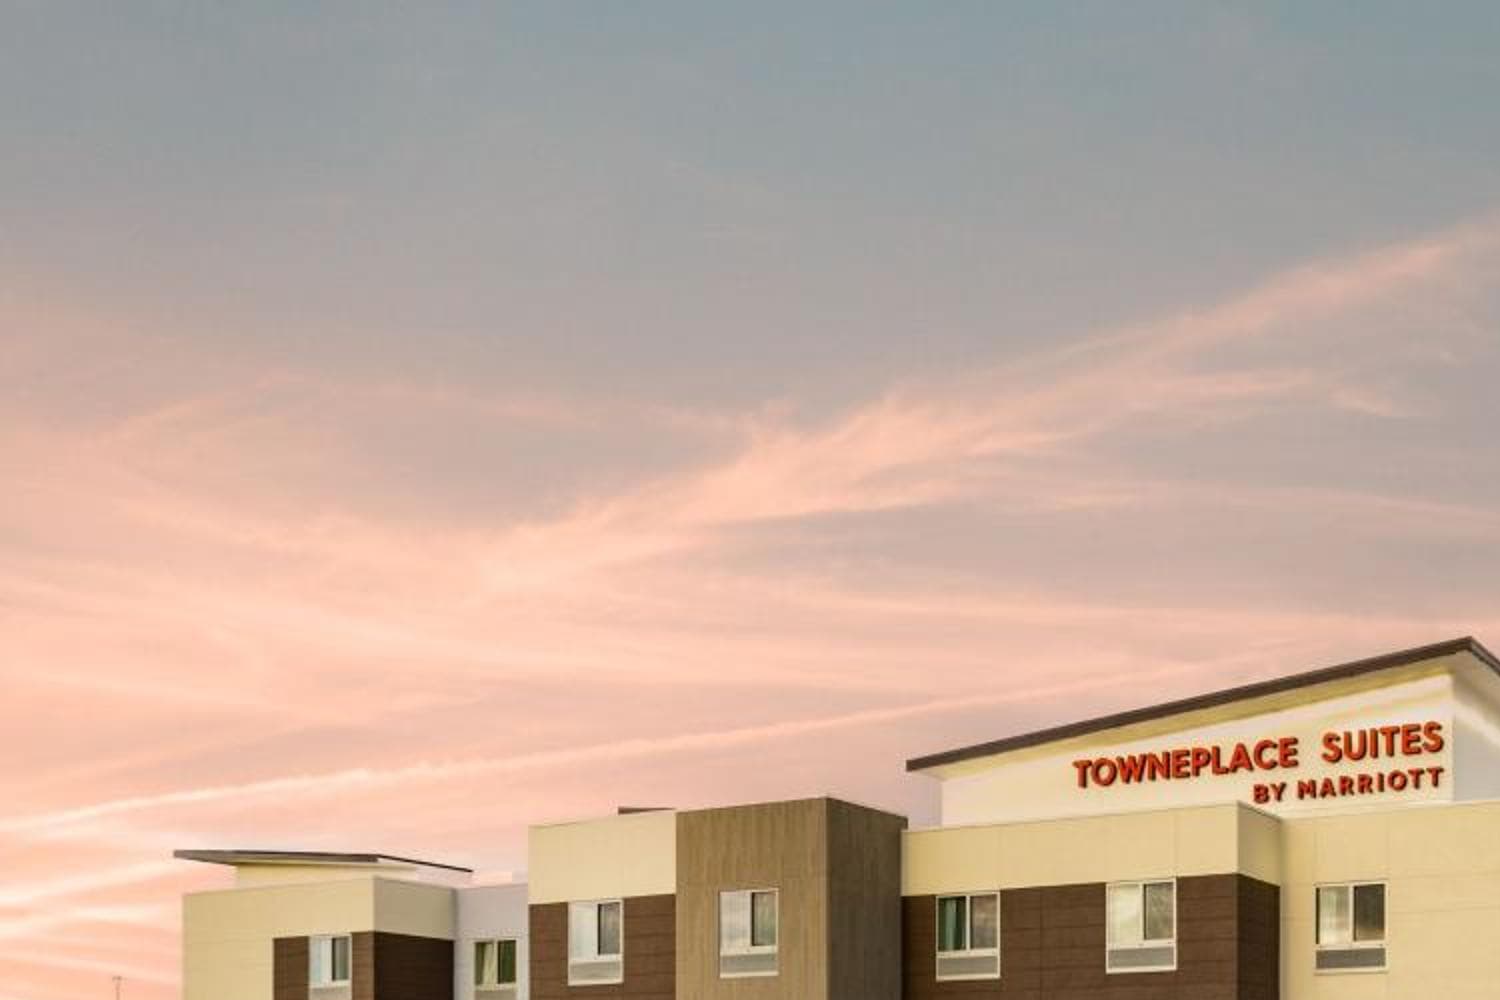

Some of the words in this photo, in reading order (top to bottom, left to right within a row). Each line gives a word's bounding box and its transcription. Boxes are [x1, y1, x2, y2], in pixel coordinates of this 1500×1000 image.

[1073, 737, 1298, 788] TOWNEPLACE
[1322, 721, 1443, 763] SUITES
[1253, 781, 1286, 804] BY
[1298, 767, 1443, 800] MARRIOTT
